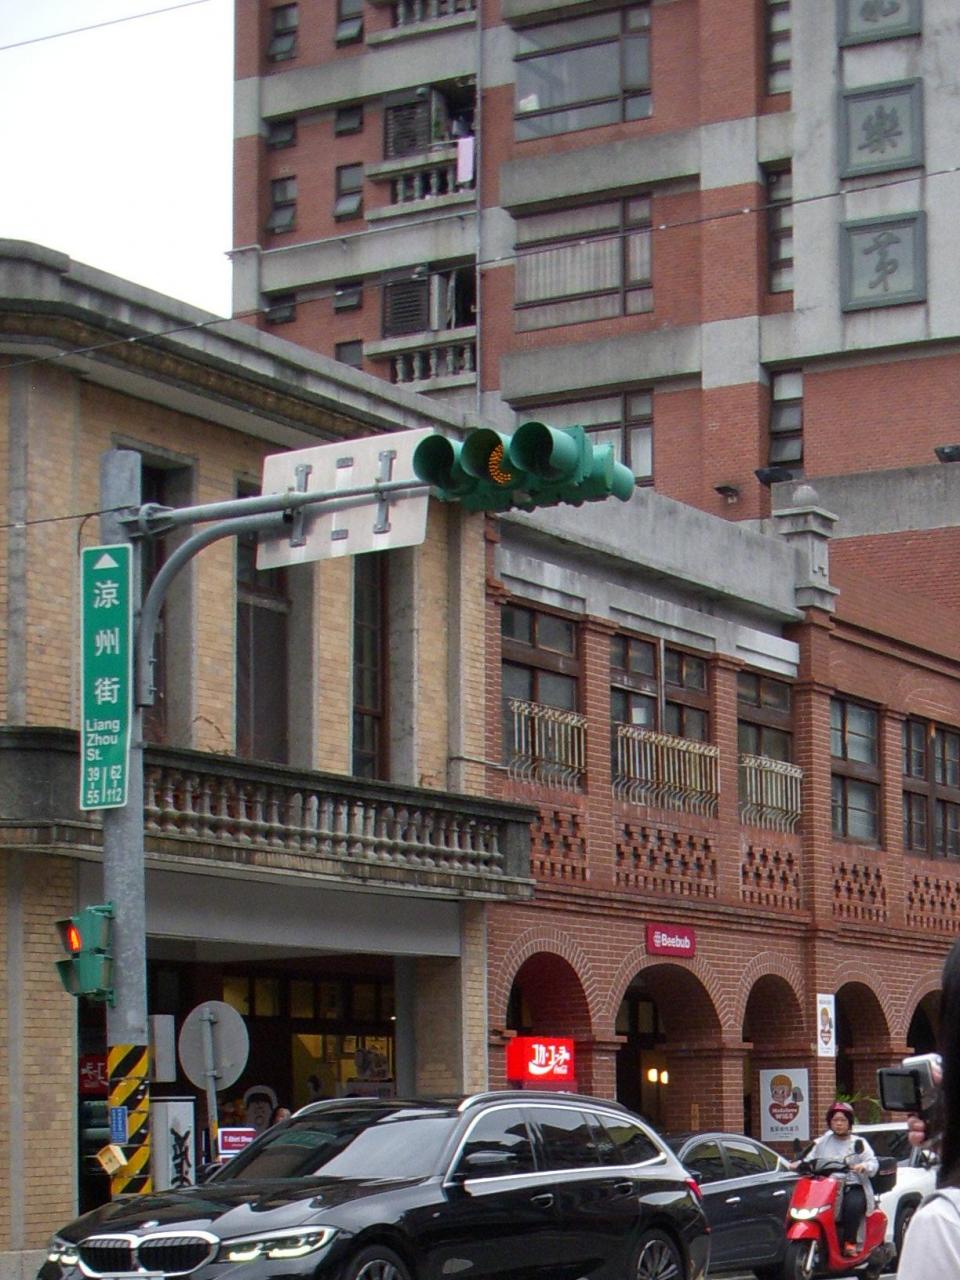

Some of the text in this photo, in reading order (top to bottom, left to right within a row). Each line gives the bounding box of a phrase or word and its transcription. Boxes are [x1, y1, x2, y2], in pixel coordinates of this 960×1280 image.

[93, 579, 121, 706] 涼州街
[85, 719, 121, 733] Liang
[86, 733, 118, 747] Zhou
[86, 748, 103, 761] St.
[87, 767, 100, 782] 39
[110, 765, 122, 779] 62
[86, 790, 100, 804] 55
